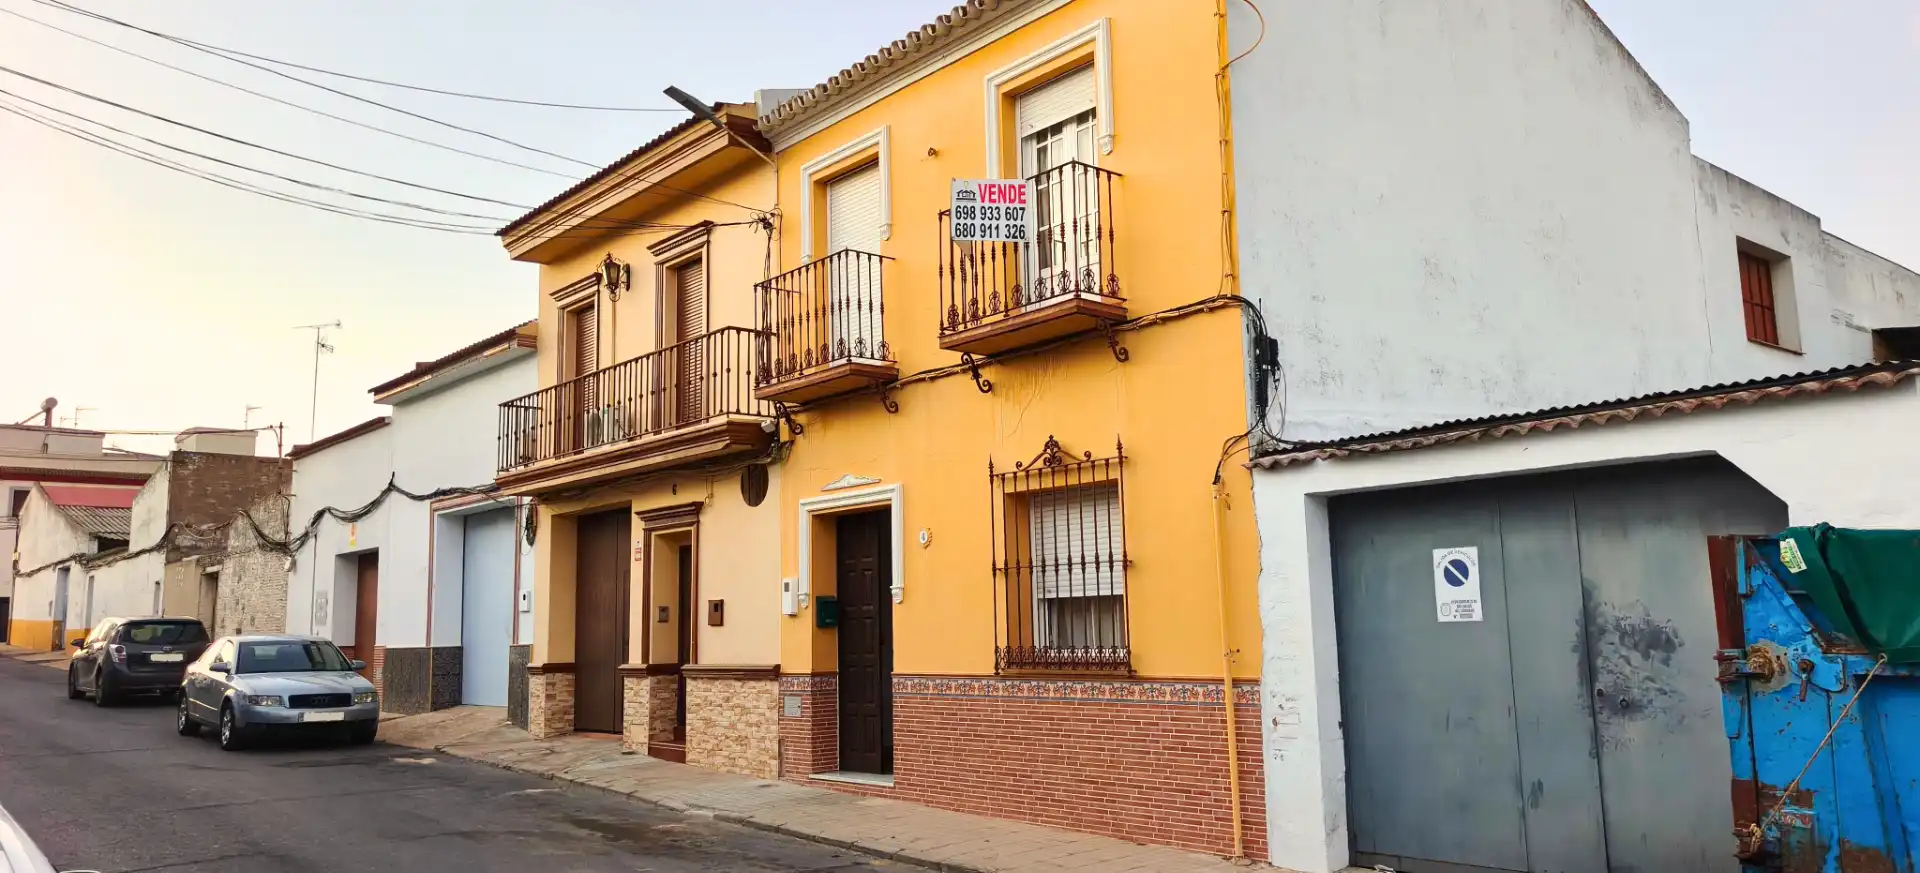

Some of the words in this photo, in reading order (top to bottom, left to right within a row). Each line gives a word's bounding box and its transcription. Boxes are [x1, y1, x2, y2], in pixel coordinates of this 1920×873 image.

[978, 183, 1027, 204] VENDE
[955, 205, 976, 220] 698
[980, 206, 1001, 221] 933
[1005, 206, 1026, 221] 607
[955, 222, 976, 238] 680
[980, 223, 1000, 238] 911
[1005, 224, 1026, 240] 326
